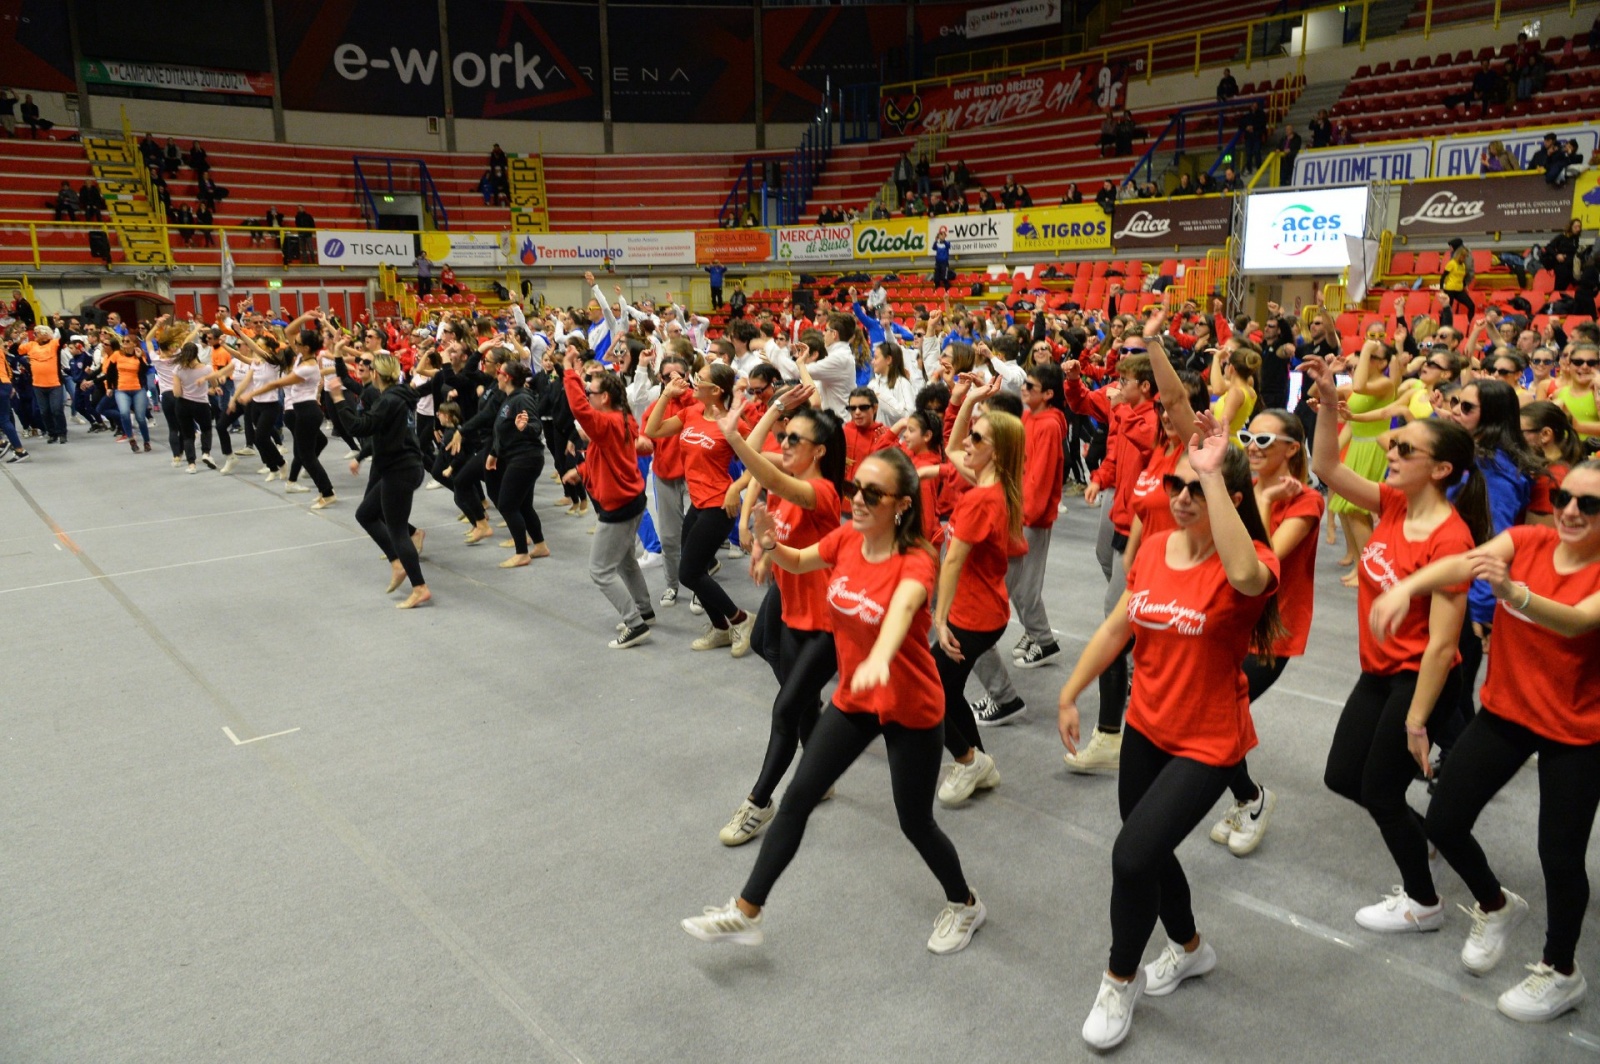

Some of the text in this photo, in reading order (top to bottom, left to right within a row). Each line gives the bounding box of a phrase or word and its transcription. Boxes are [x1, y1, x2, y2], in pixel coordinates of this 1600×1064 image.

[333, 41, 544, 90] e-work
[544, 65, 691, 82] ARENA
[118, 63, 165, 84] CAMPIONE
[165, 67, 199, 87] D'ITALIA
[200, 71, 239, 89] 2011/2012
[973, 83, 1004, 97] BUSTO
[1006, 77, 1045, 94] ARSIZIO
[963, 89, 1045, 124] SEMPER
[1045, 72, 1083, 113] CHI
[1303, 153, 1415, 185] AVIOMETAL
[512, 159, 540, 206] STEP
[1399, 190, 1485, 226] Laica
[1042, 220, 1106, 238] TIGROS
[1113, 210, 1171, 240] Laica
[1282, 214, 1341, 232] aces
[780, 227, 851, 242] MERCATINO
[857, 229, 924, 253] Ricola
[1024, 239, 1054, 248] FRESCO
[1075, 237, 1106, 245] BUONO
[350, 243, 408, 256] TISCALI
[537, 245, 623, 260] TermoLuongo
[806, 237, 849, 253] di Busto
